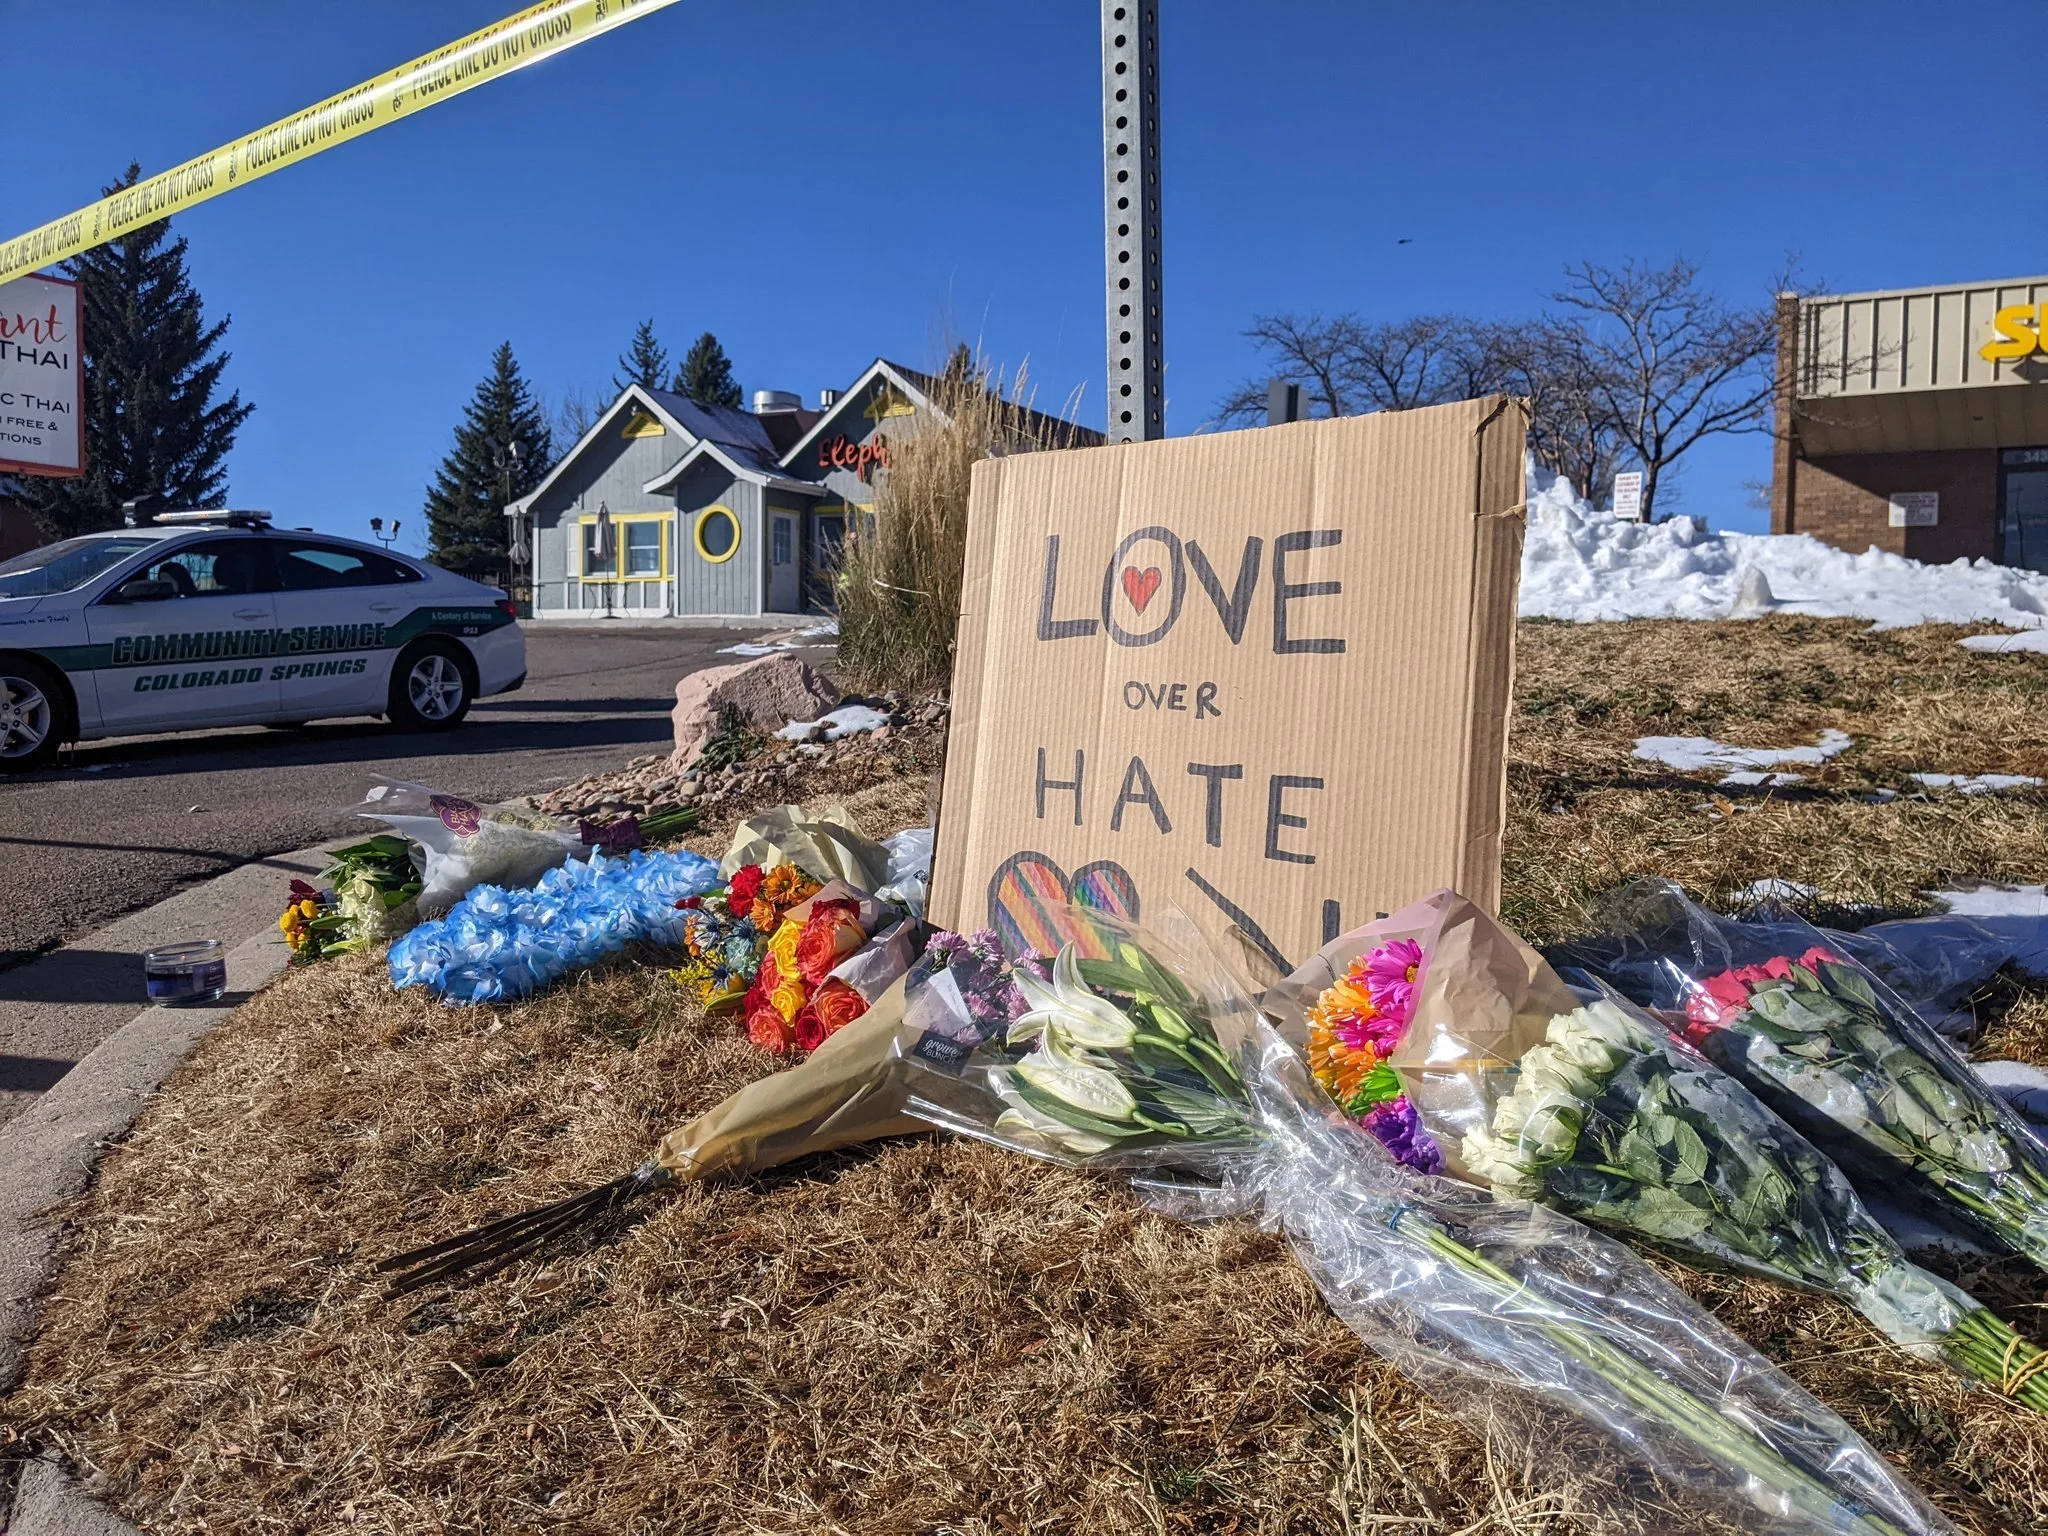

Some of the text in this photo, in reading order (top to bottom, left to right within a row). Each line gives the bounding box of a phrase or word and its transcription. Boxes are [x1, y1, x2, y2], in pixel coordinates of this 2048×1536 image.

[413, 48, 451, 100] POLICE
[454, 36, 480, 82] LINE
[483, 27, 498, 69] DO
[503, 15, 527, 61] NOT
[245, 127, 278, 172] POLICE
[279, 117, 301, 157] LINE
[302, 109, 317, 147] DO
[318, 99, 340, 140] NOT
[340, 83, 375, 130] CROSS
[107, 192, 135, 231] POLICE
[135, 183, 155, 219] LINE
[154, 177, 167, 211] DO
[168, 168, 186, 205] NOT
[186, 155, 215, 197] CROSS
[15, 238, 31, 270] LINE
[31, 232, 42, 263] DO
[41, 225, 58, 258] NOT
[57, 214, 82, 252] CROSS
[0, 340, 68, 370] THAI
[7, 416, 45, 430] FREE
[47, 421, 59, 432] &
[20, 393, 70, 414] THAI
[1036, 526, 1346, 655] LOVE
[111, 622, 386, 665] COMMUNITY SERVICE
[133, 658, 368, 693] COLORADO SPRINGS
[1123, 681, 1222, 719] OVER
[1035, 747, 1324, 864] HATE
[926, 1049, 956, 1065] BUNCH
